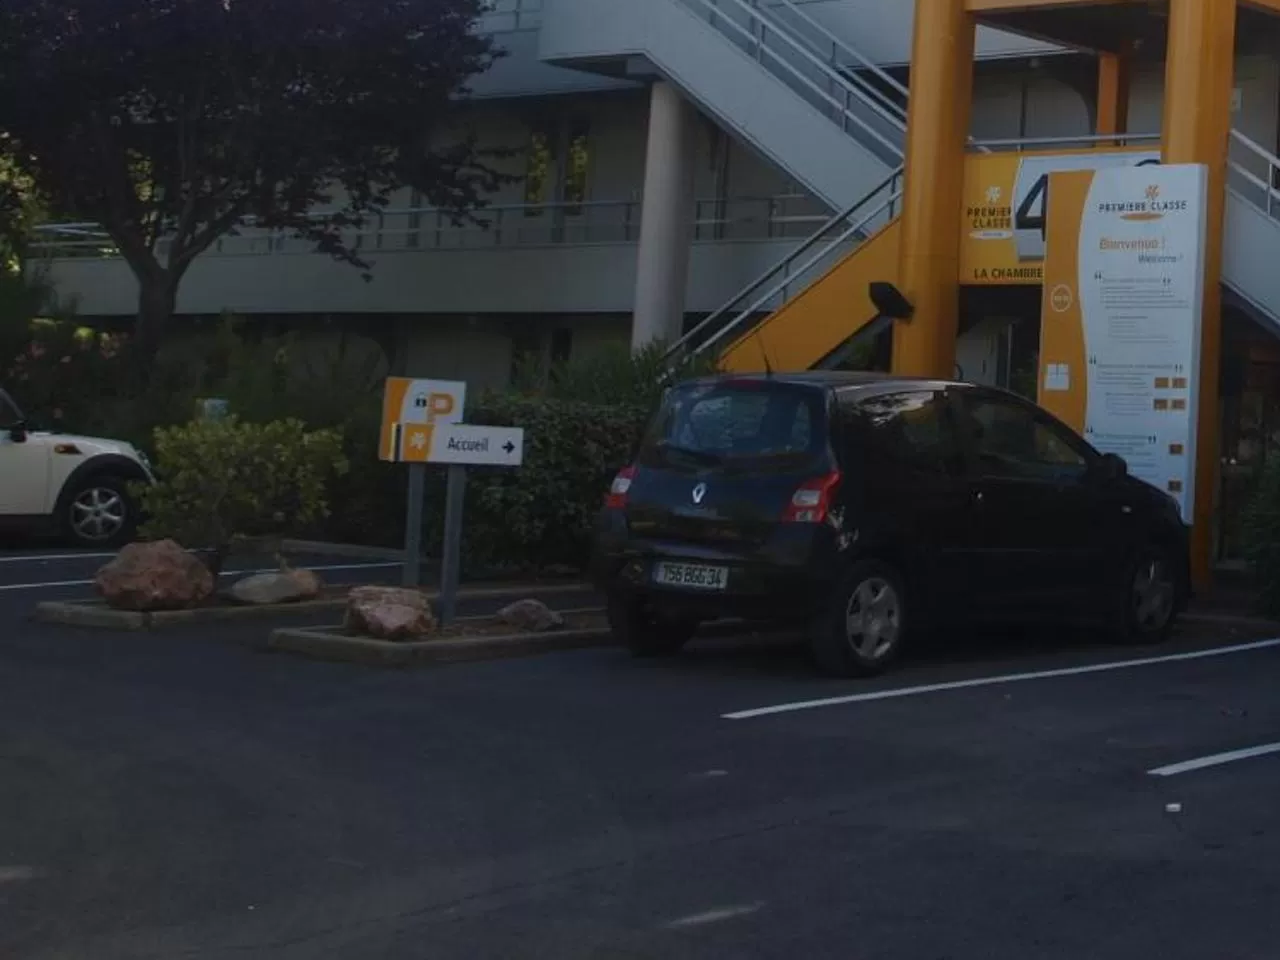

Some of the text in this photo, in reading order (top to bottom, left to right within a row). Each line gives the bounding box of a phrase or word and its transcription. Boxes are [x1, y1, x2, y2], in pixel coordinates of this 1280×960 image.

[1098, 200, 1188, 213] PREMIERE CLASSE
[973, 267, 988, 280] LA
[448, 436, 489, 453] Accueil
